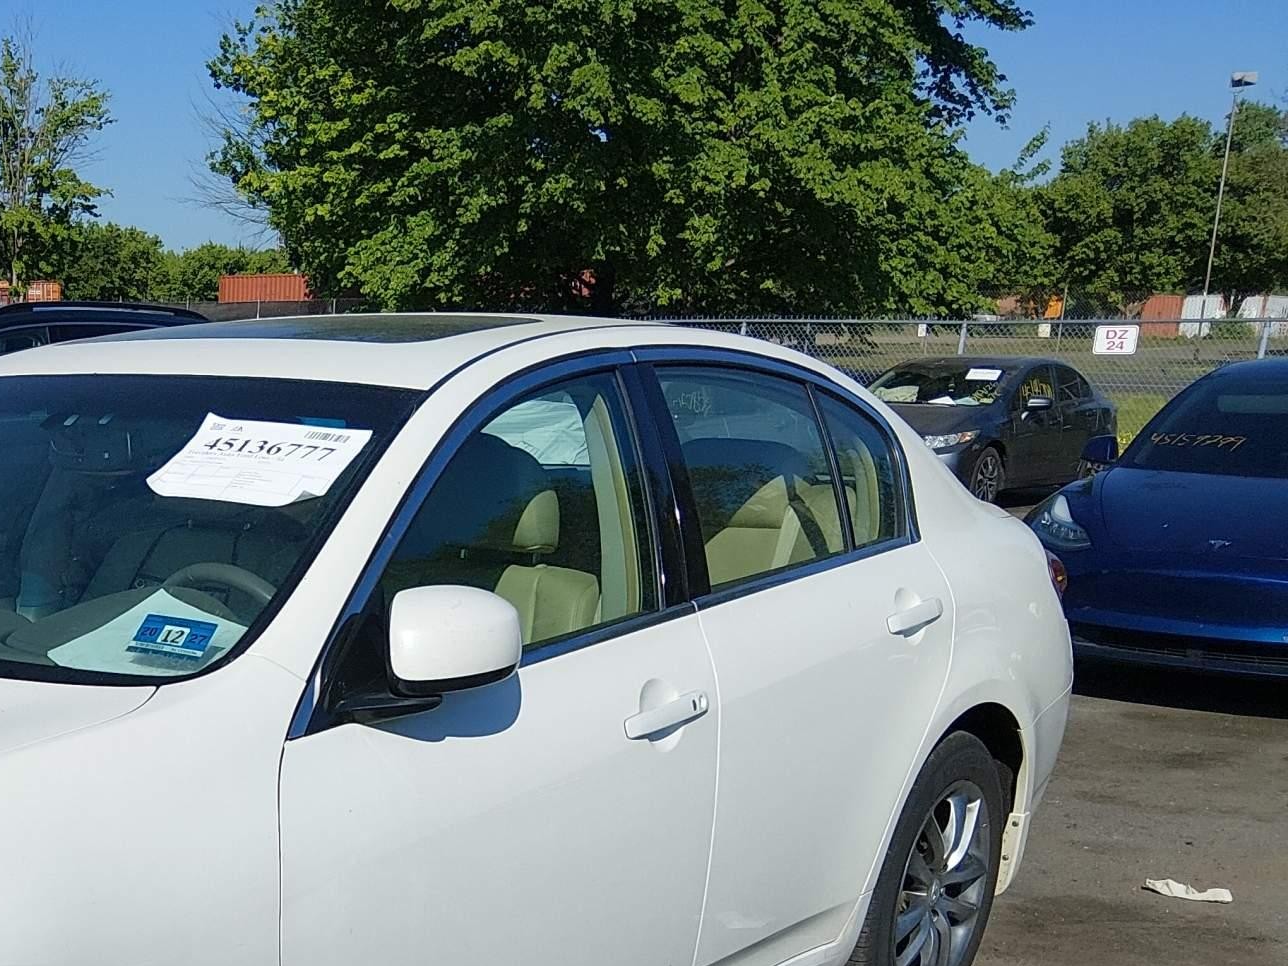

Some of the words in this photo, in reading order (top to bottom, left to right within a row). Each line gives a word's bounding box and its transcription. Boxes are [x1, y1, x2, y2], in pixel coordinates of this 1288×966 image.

[1106, 329, 1129, 340] DZ
[1106, 340, 1125, 351] 24
[204, 437, 337, 461] 45136777
[161, 629, 185, 644] 12
